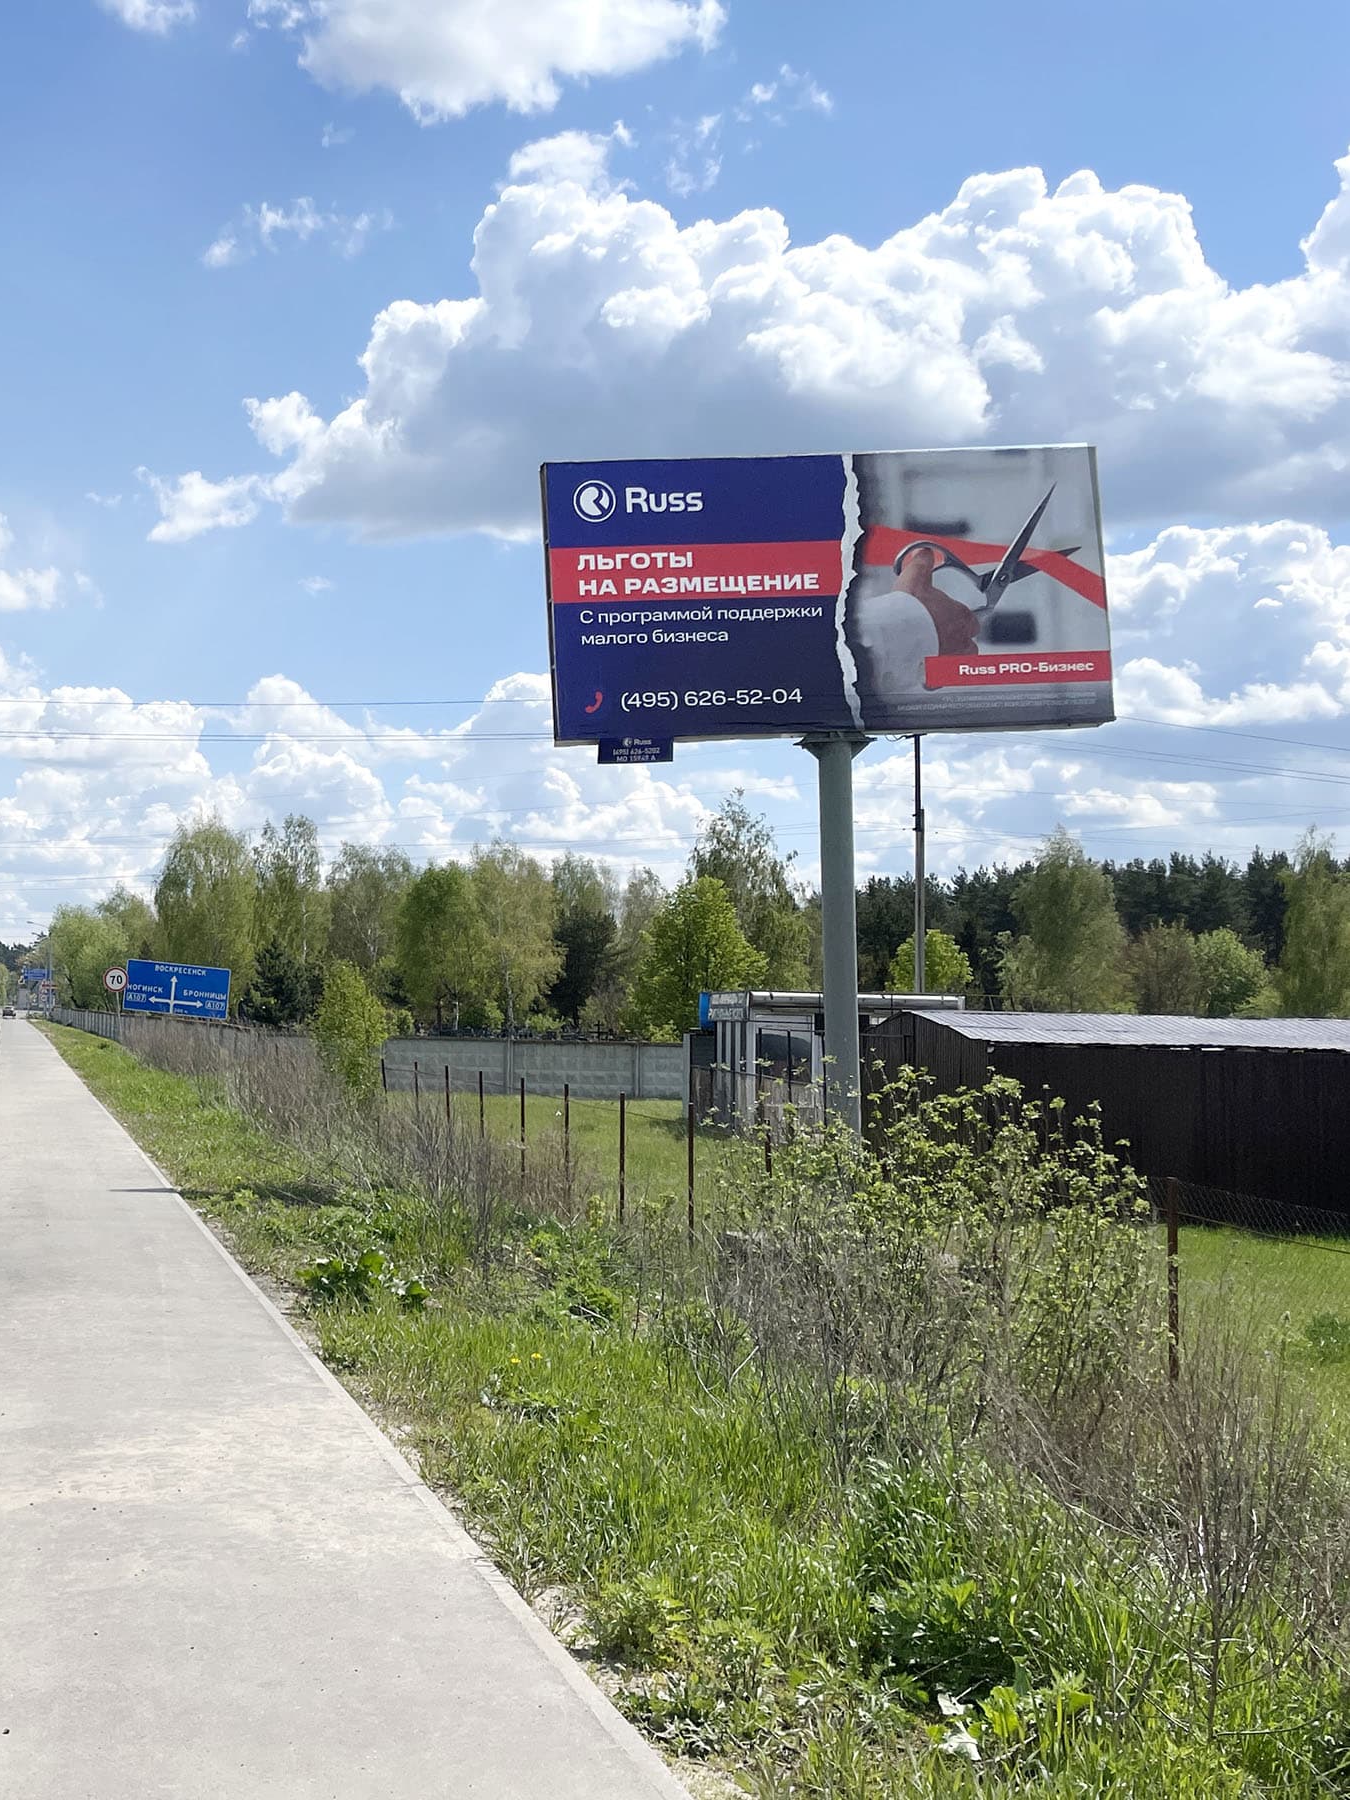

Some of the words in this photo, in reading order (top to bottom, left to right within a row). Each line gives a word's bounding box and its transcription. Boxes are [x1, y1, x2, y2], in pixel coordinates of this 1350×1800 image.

[625, 486, 704, 513] Russ
[577, 552, 693, 571] ЛЬГОТЫ
[578, 579, 618, 596] НА
[624, 573, 820, 595] РАЗМЕЩЕНИЕ
[580, 610, 594, 624] С
[598, 606, 713, 626] программой
[717, 606, 823, 621] поддержки
[581, 632, 648, 646] малого
[652, 629, 729, 643] бизнеса
[959, 664, 996, 676] Russ
[999, 661, 1095, 674] PRO-Бизнес
[621, 691, 679, 712] (495)
[684, 688, 803, 706] 626-52-04
[154, 964, 207, 976] ВОСКРЕСЕНСК
[110, 975, 123, 984] 70
[127, 984, 163, 993] НОГИНСК
[183, 989, 227, 1000] БРОННИЦЫ
